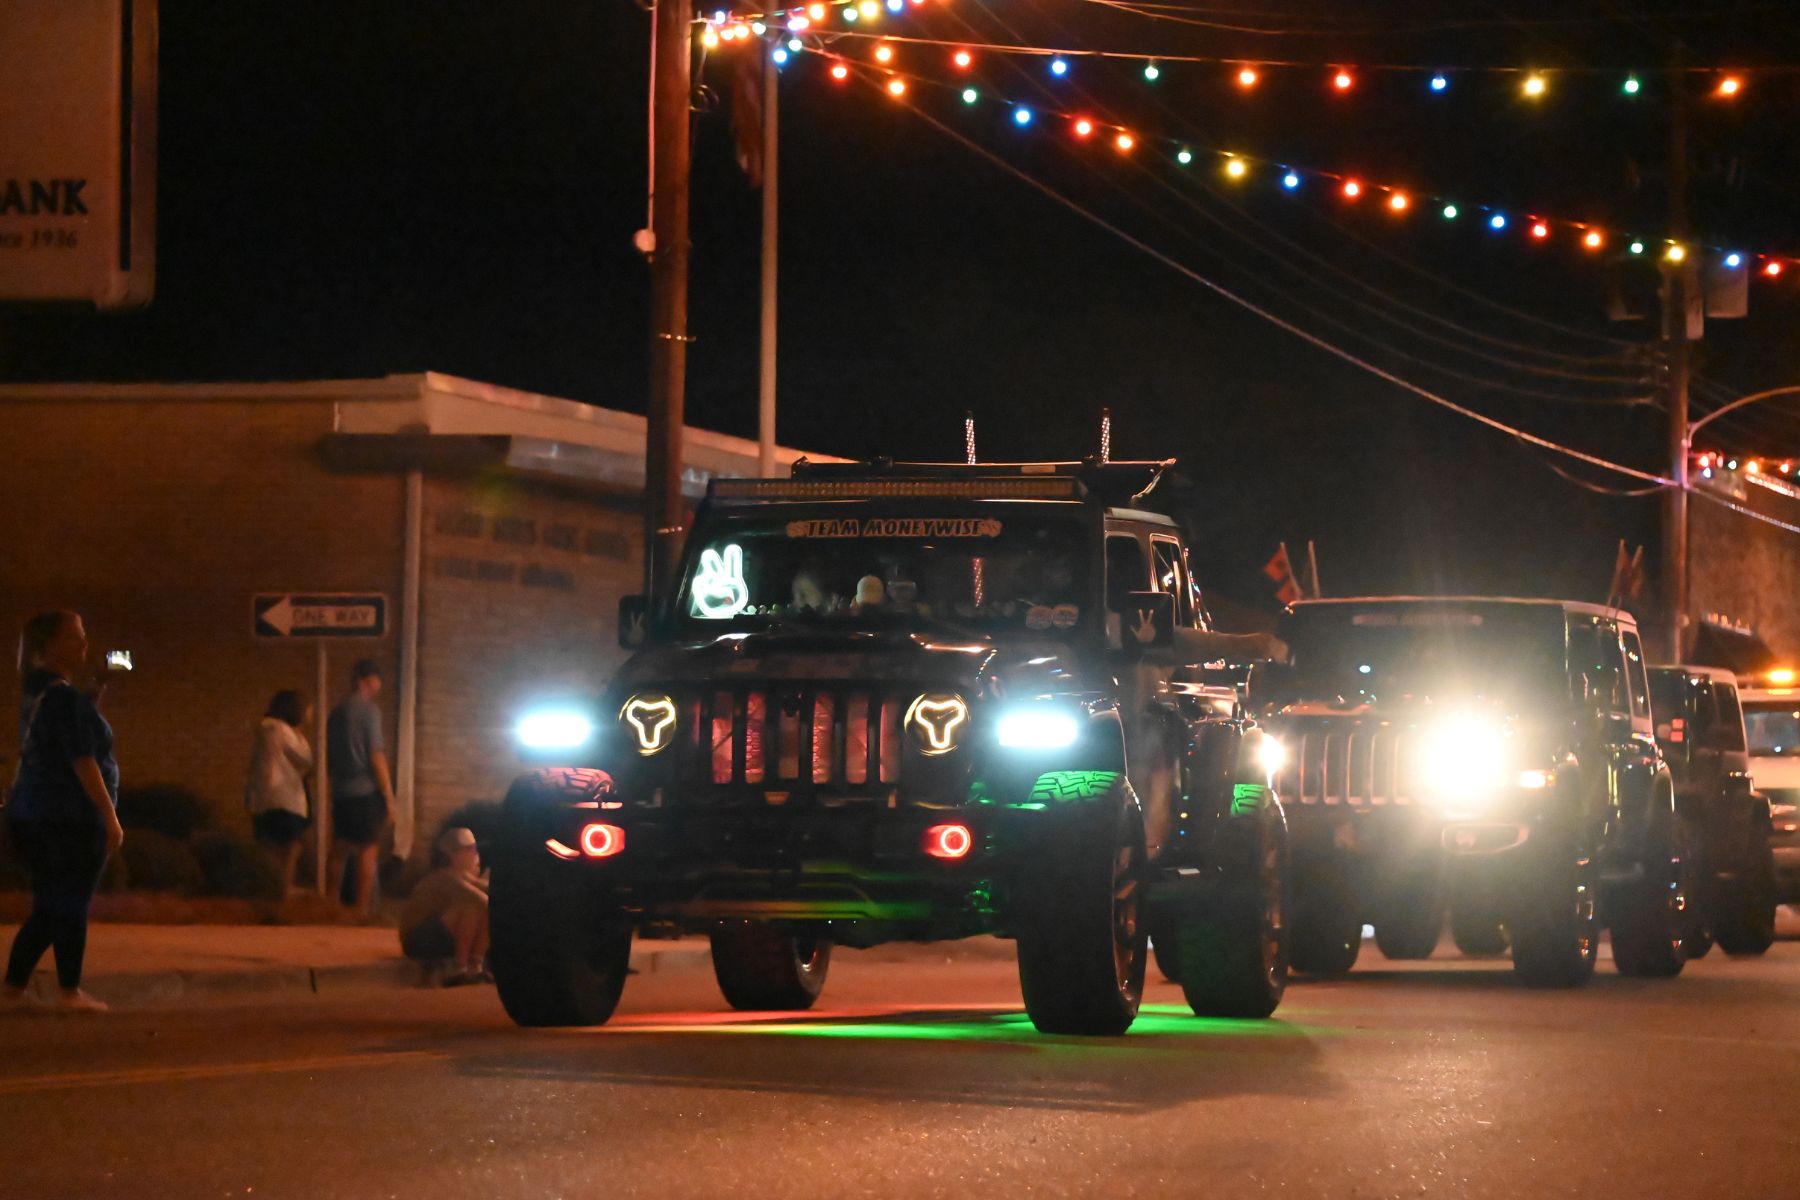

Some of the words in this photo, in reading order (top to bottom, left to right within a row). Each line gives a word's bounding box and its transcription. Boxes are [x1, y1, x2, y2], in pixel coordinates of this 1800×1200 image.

[807, 520, 858, 536] TEAM
[864, 519, 982, 536] MONEYWISE
[293, 607, 326, 625] ONE
[335, 607, 370, 625] WAY
